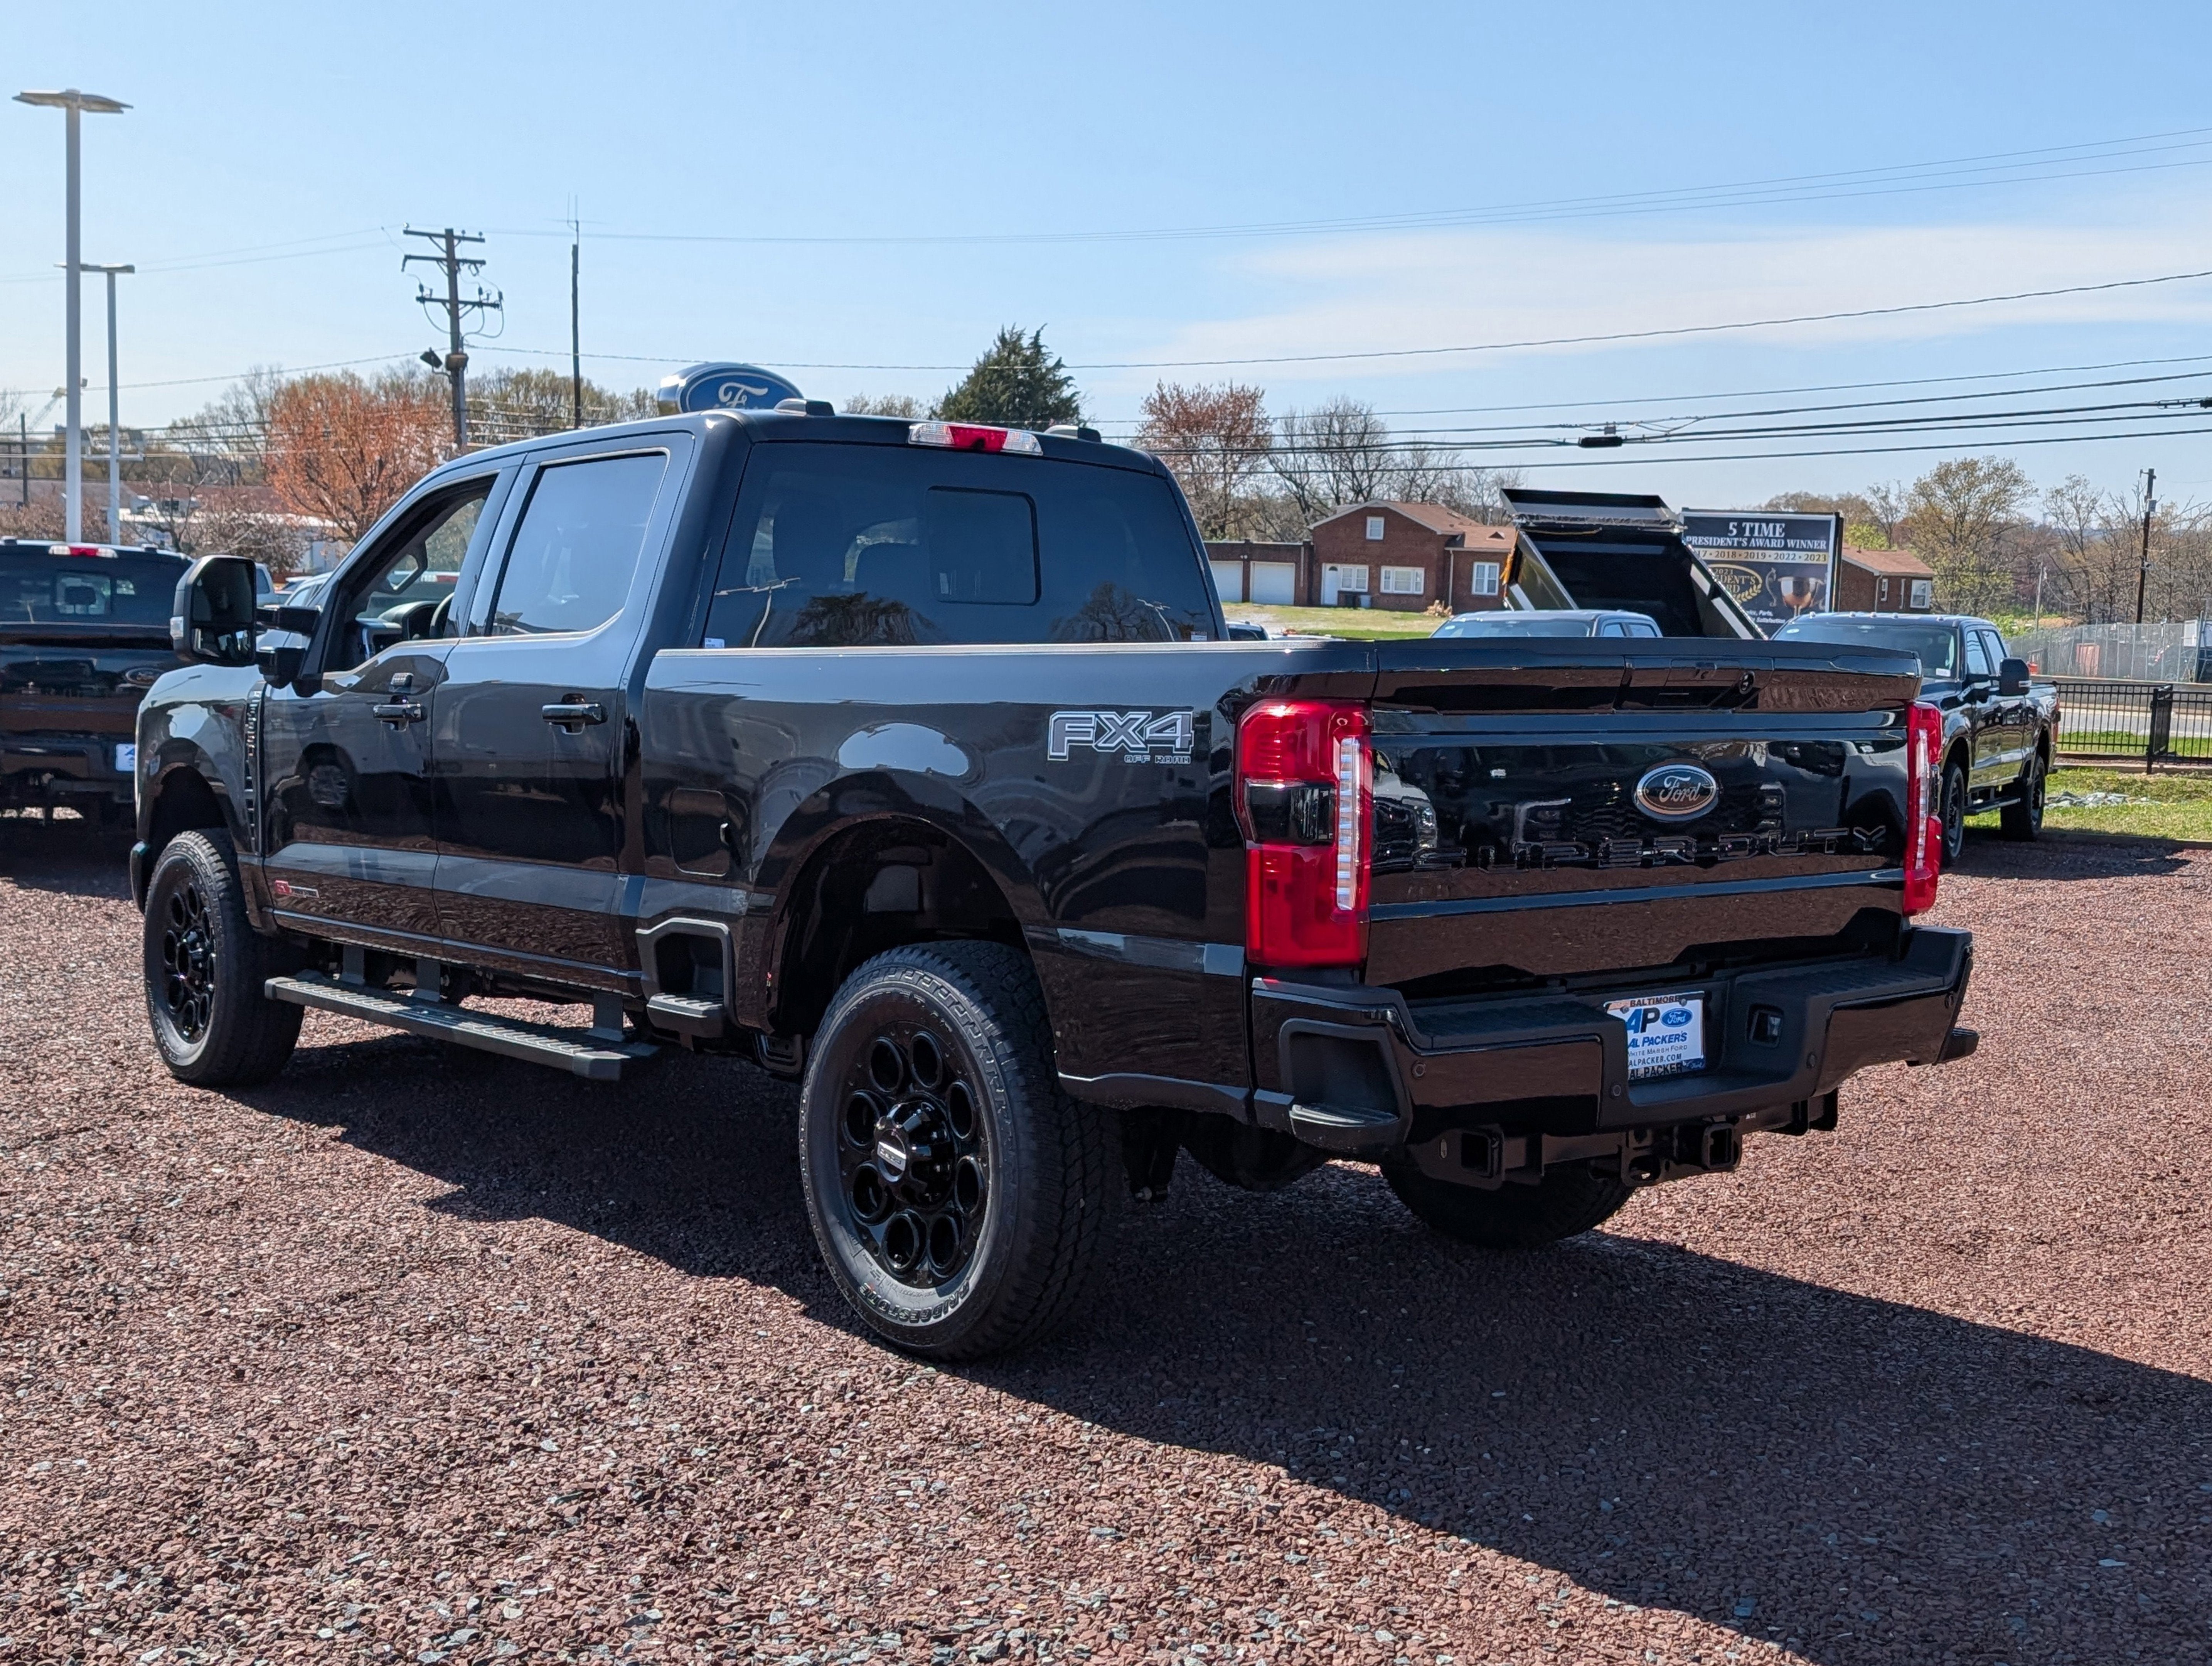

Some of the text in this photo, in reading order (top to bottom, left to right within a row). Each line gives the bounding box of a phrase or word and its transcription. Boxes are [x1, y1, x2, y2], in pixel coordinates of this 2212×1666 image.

[1728, 522, 1786, 538] 5 TIME
[1685, 536, 1826, 550] PRESIDENT'S AWARD WINNER
[1714, 550, 1737, 559] 2018
[1744, 551, 1766, 560] 2019
[1774, 553, 1796, 562] 2022
[1803, 553, 1826, 563] 2023
[1717, 575, 1755, 585] DENT'S
[1047, 711, 1194, 761] FX4
[1124, 754, 1191, 764] OFF ROAD
[1659, 775, 1701, 803] Ford
[1412, 825, 1887, 874] SUPER DUTY
[1630, 995, 1679, 1007] BALTIMORE
[1668, 1011, 1686, 1024] Ford
[1627, 1030, 1687, 1048] AL PACKER'S
[1646, 1046, 1670, 1055] MARSH
[1628, 1053, 1682, 1067] ALPACKER.COM
[1629, 1061, 1683, 1080] AL PACKER
[859, 1280, 970, 1323] BRIDGESTONE
